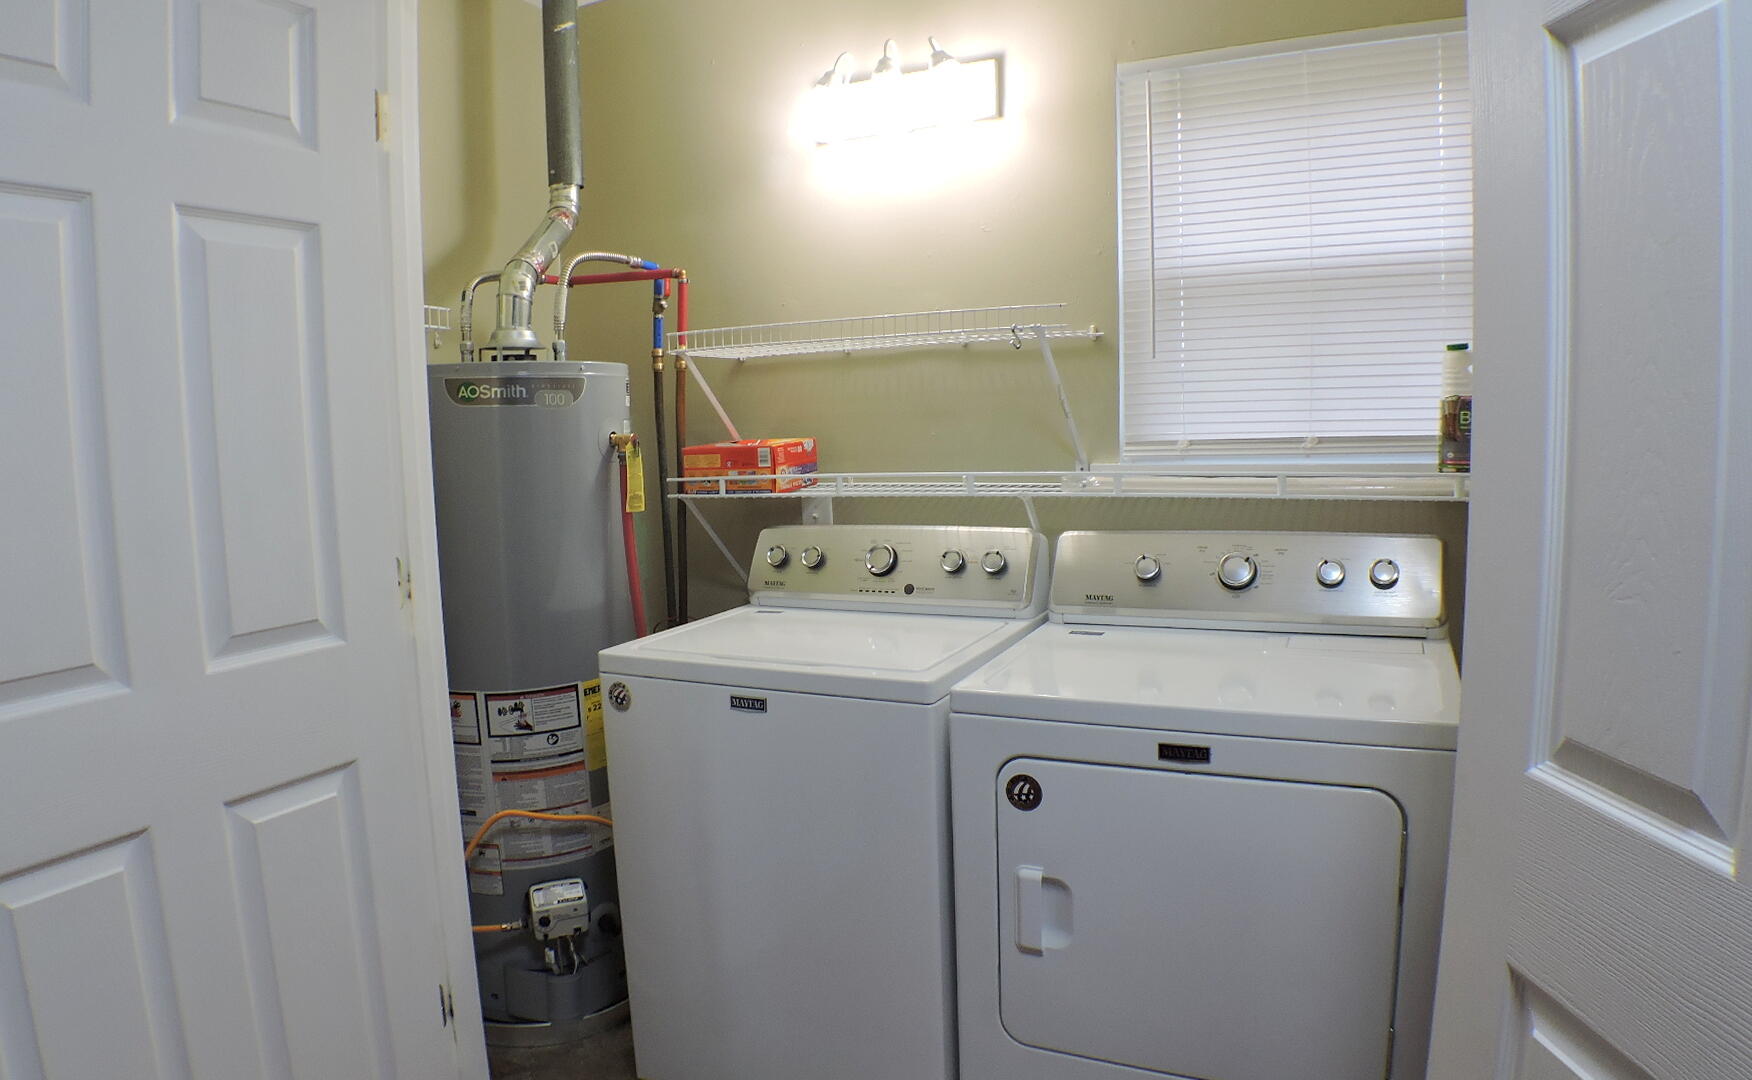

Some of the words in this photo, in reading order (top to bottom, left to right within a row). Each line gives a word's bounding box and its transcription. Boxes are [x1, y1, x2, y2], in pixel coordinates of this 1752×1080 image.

[544, 393, 566, 406] 100
[732, 698, 764, 709] MAYTAG
[1162, 747, 1208, 760] MAYTAG
